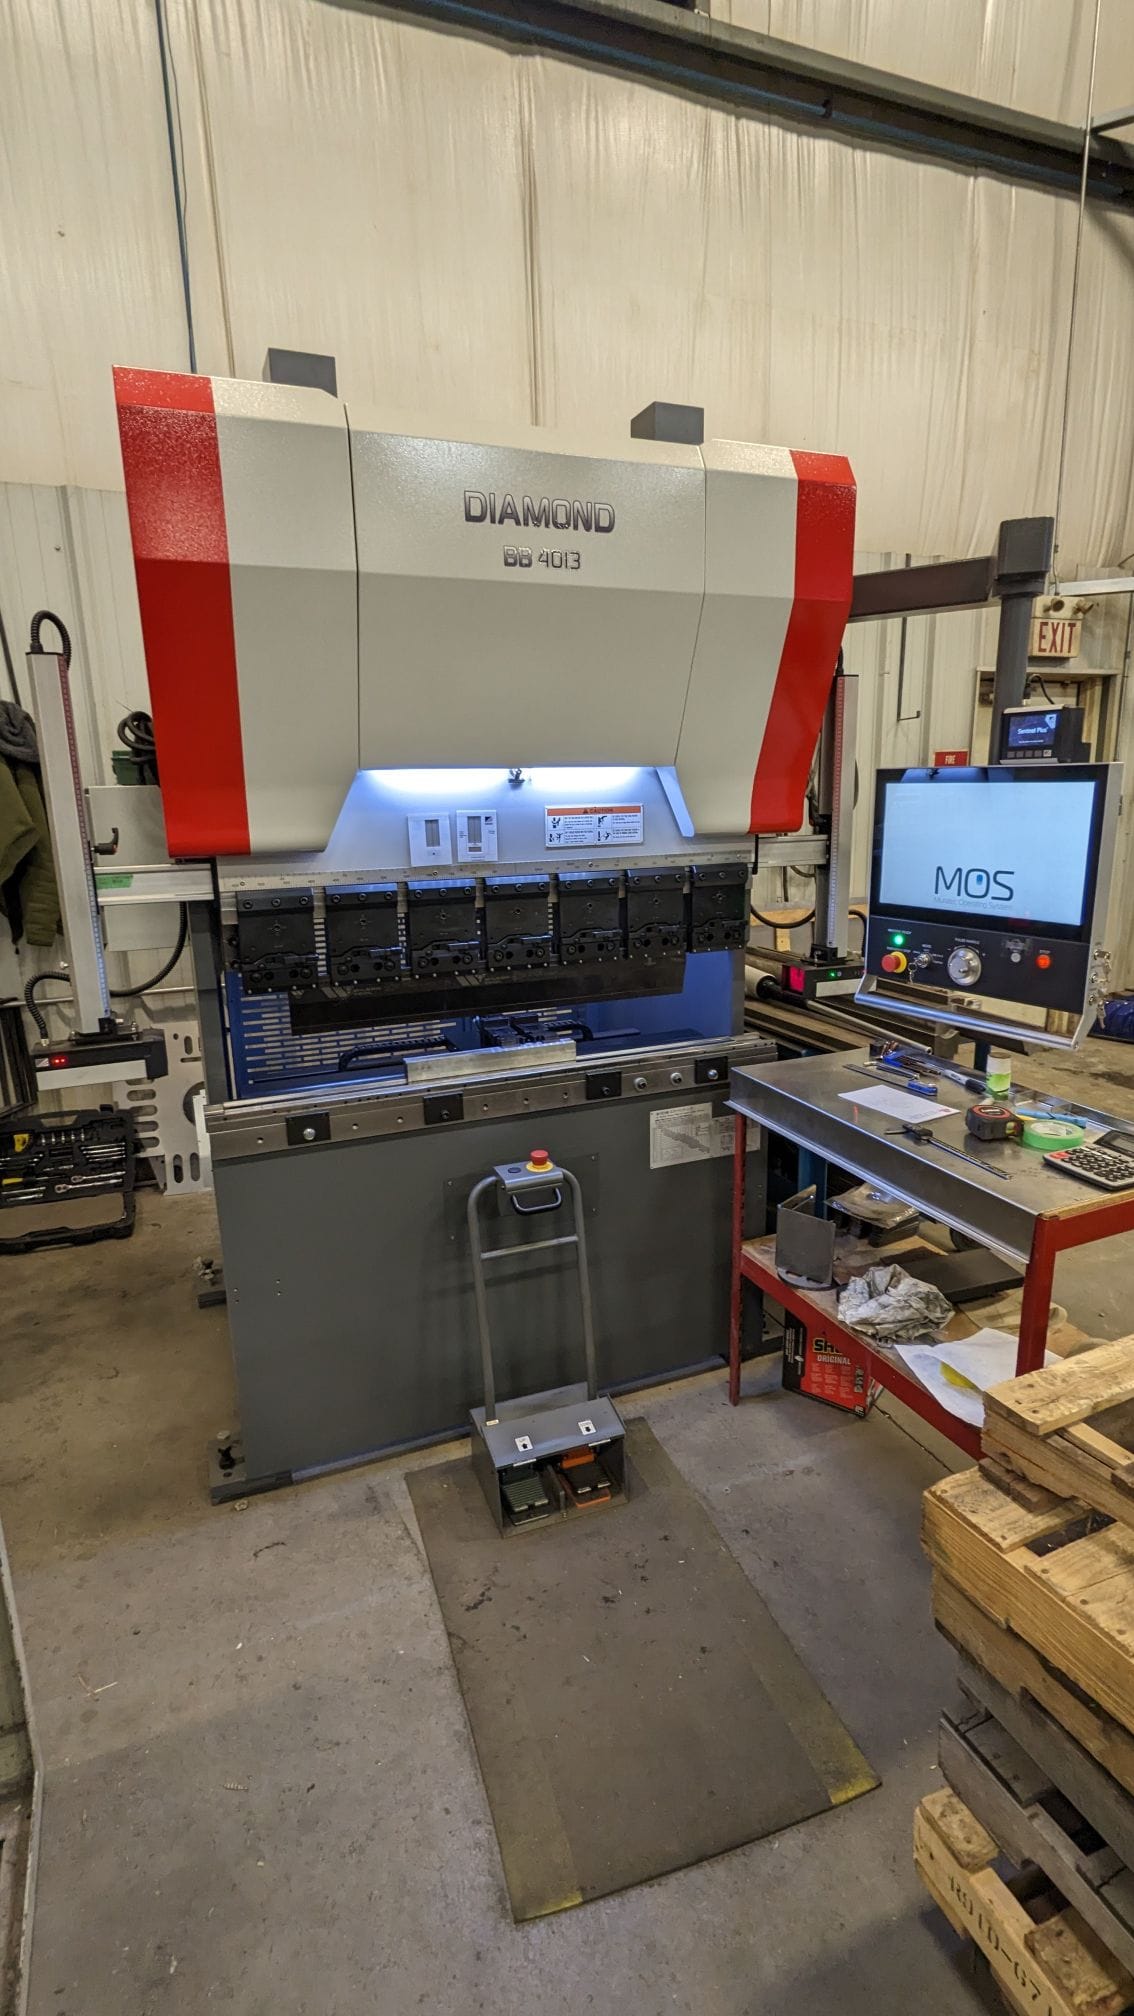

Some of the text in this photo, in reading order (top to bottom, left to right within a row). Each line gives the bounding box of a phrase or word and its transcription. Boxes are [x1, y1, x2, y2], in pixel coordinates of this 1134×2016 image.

[464, 490, 616, 533] DIAMOND
[503, 545, 581, 570] BB 4013
[1037, 621, 1077, 654] EXIT
[944, 754, 956, 765] FIRE
[934, 865, 1015, 901] MOS
[817, 1354, 852, 1365] ORIGINAL
